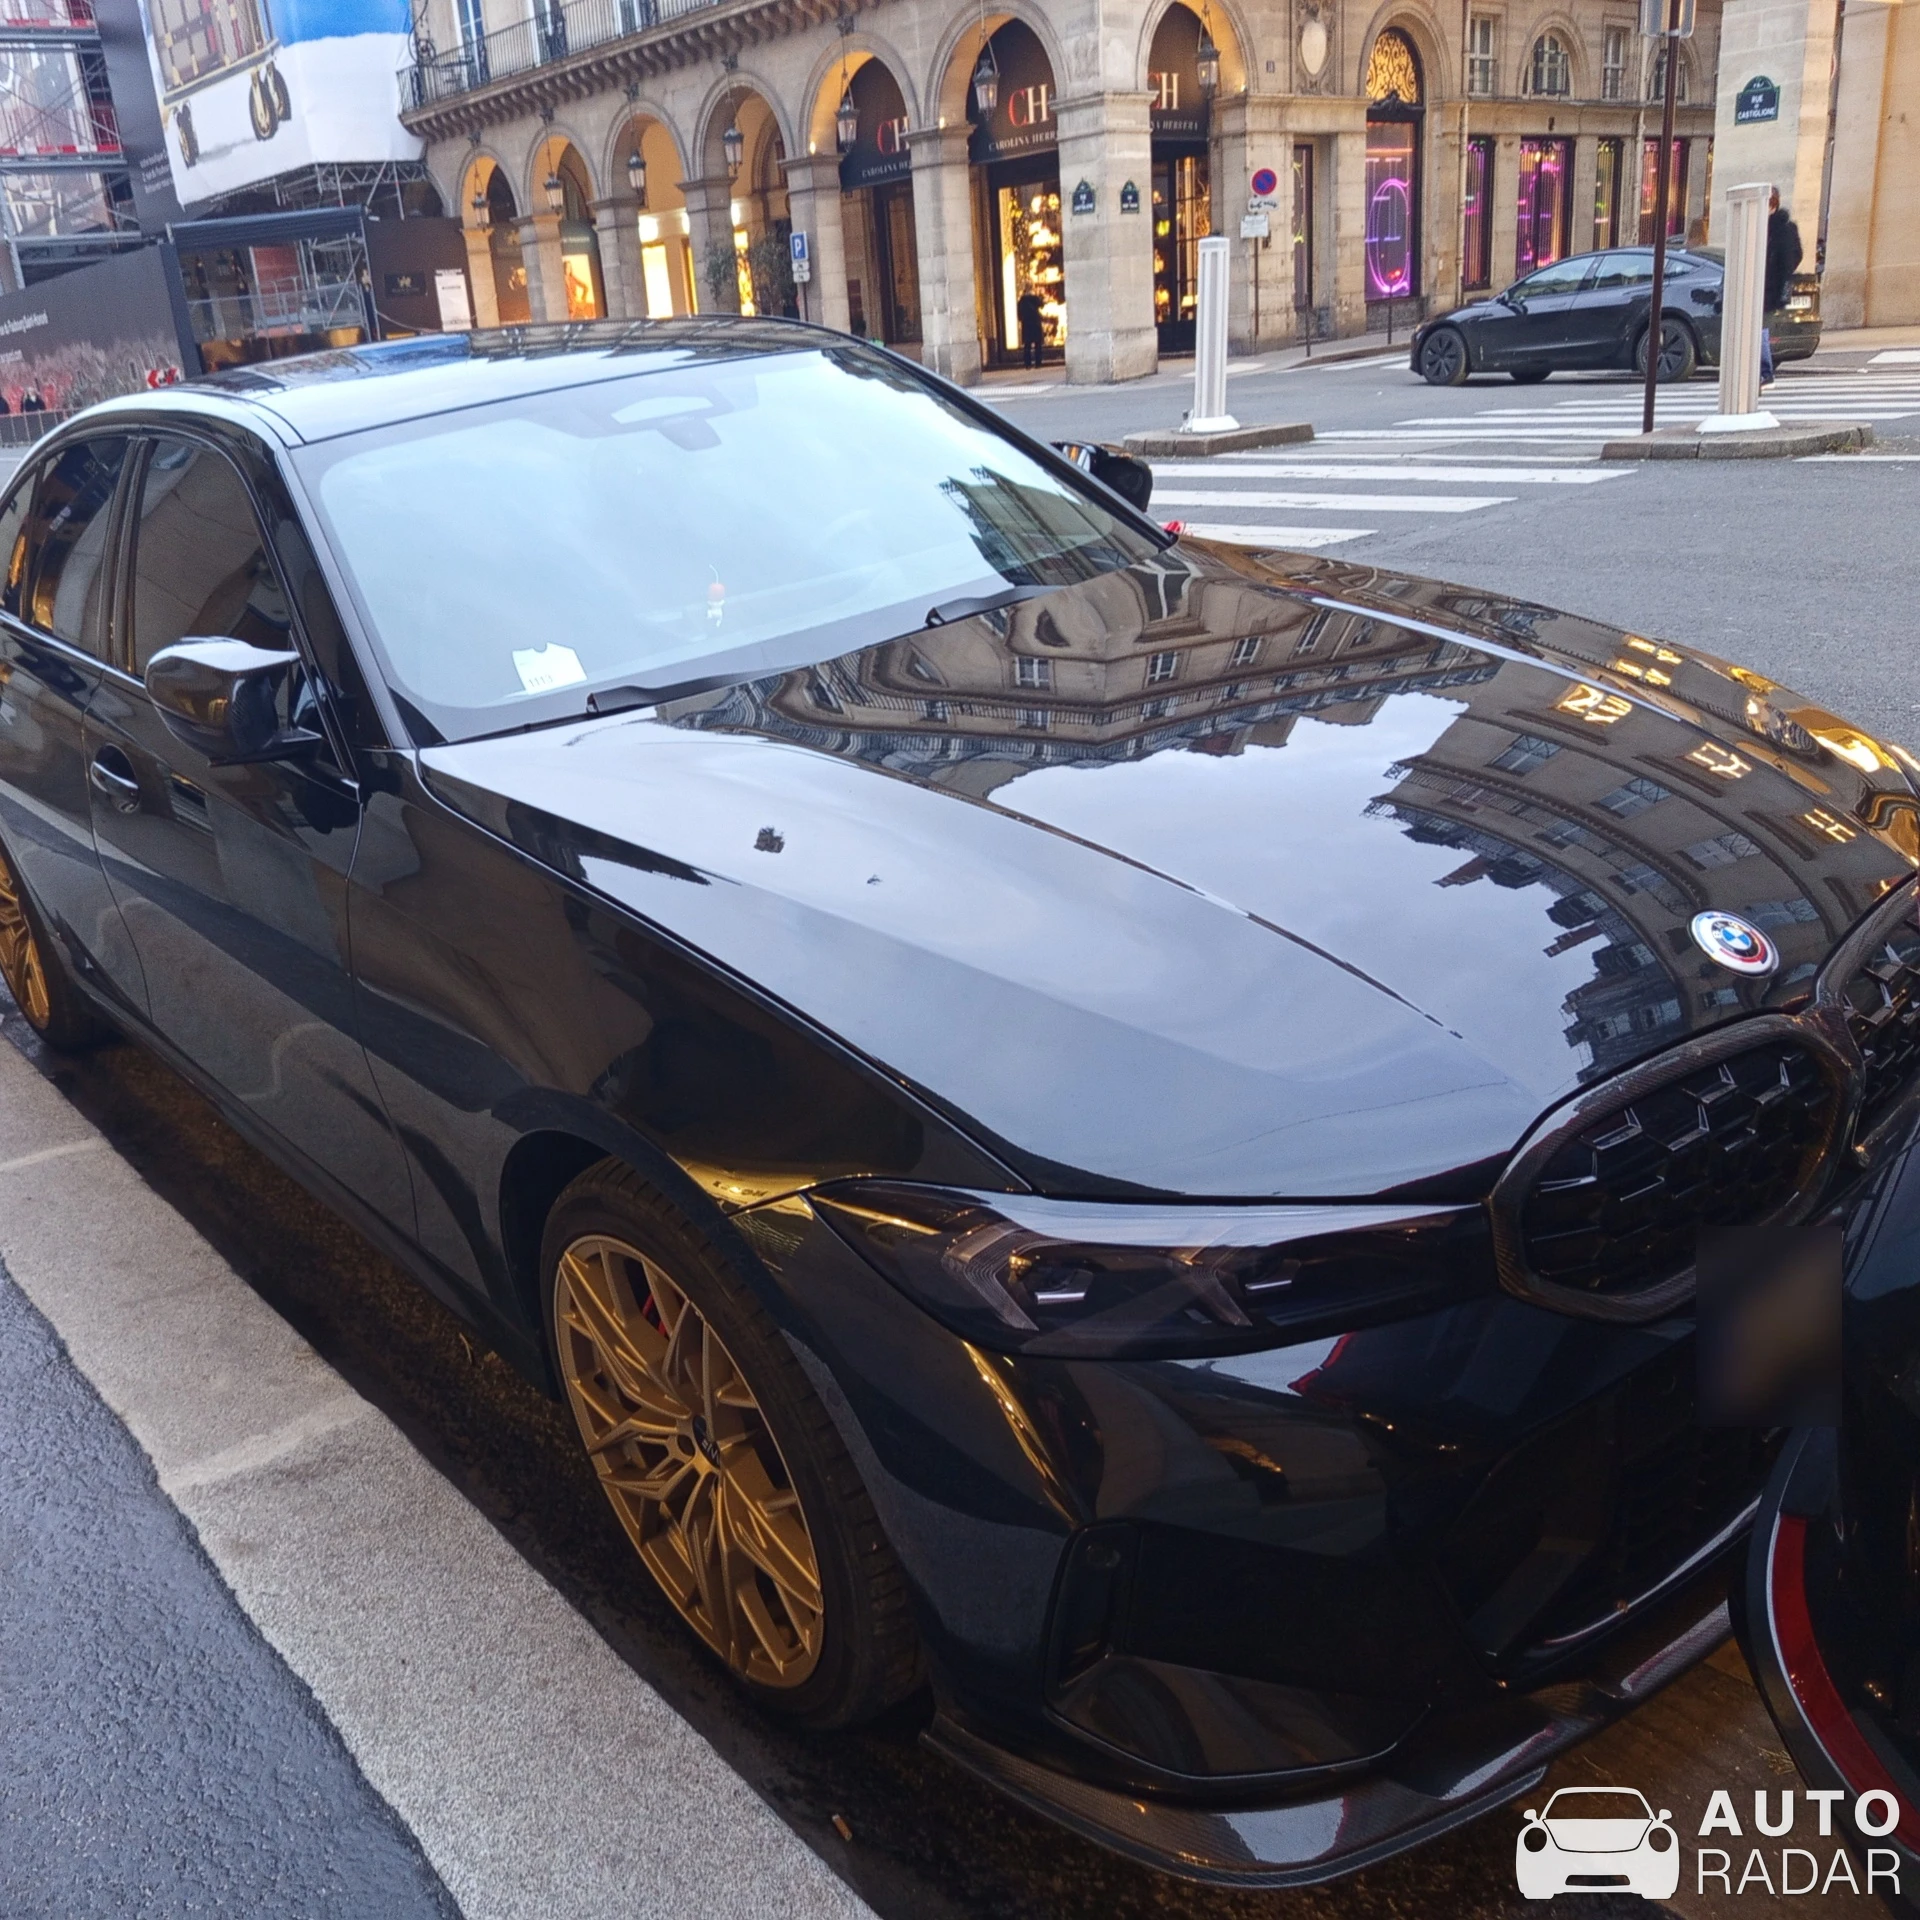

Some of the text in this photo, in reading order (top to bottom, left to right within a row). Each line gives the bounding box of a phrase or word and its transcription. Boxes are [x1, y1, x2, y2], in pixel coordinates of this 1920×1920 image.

[1008, 84, 1049, 128] CH
[1751, 94, 1763, 104] RUE
[1737, 107, 1776, 120] CASTIGLIONE
[794, 238, 803, 257] P
